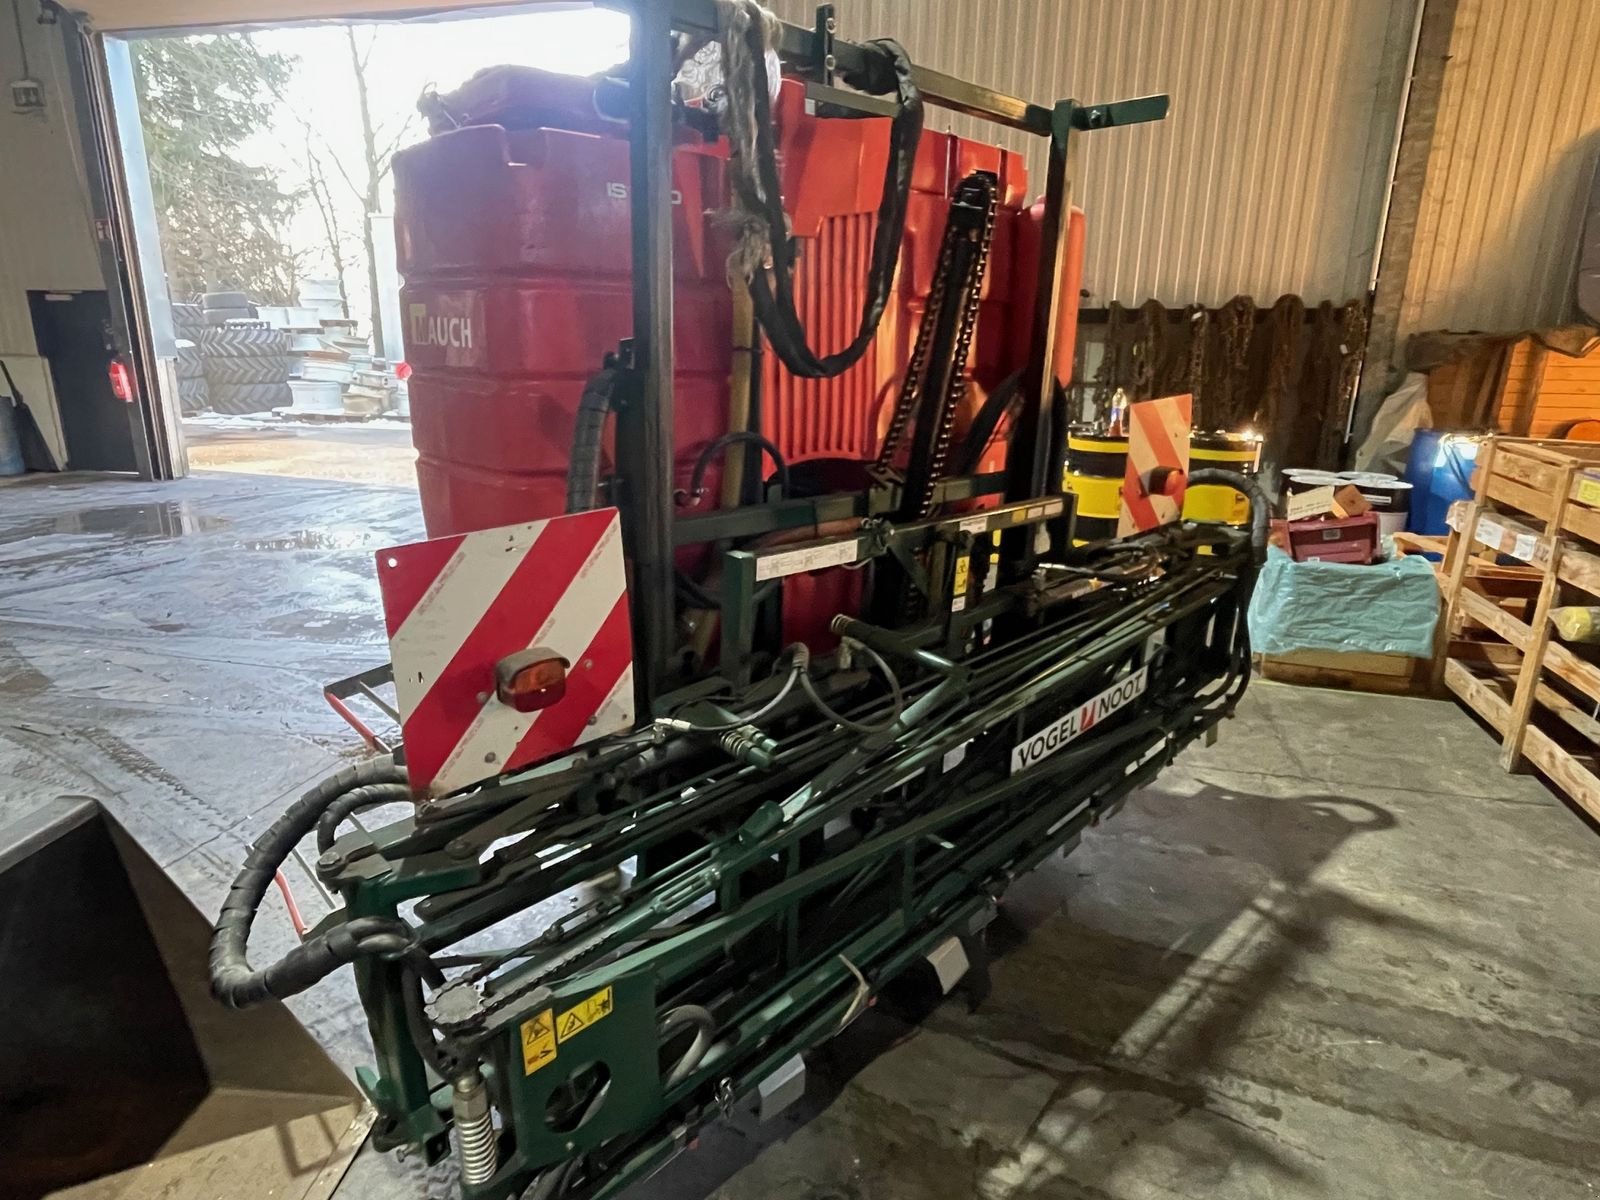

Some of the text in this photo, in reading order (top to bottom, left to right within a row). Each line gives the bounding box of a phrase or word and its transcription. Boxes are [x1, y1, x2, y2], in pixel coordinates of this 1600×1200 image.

[410, 314, 472, 348] AUCH
[1018, 672, 1144, 767] VOGEL NOOT
